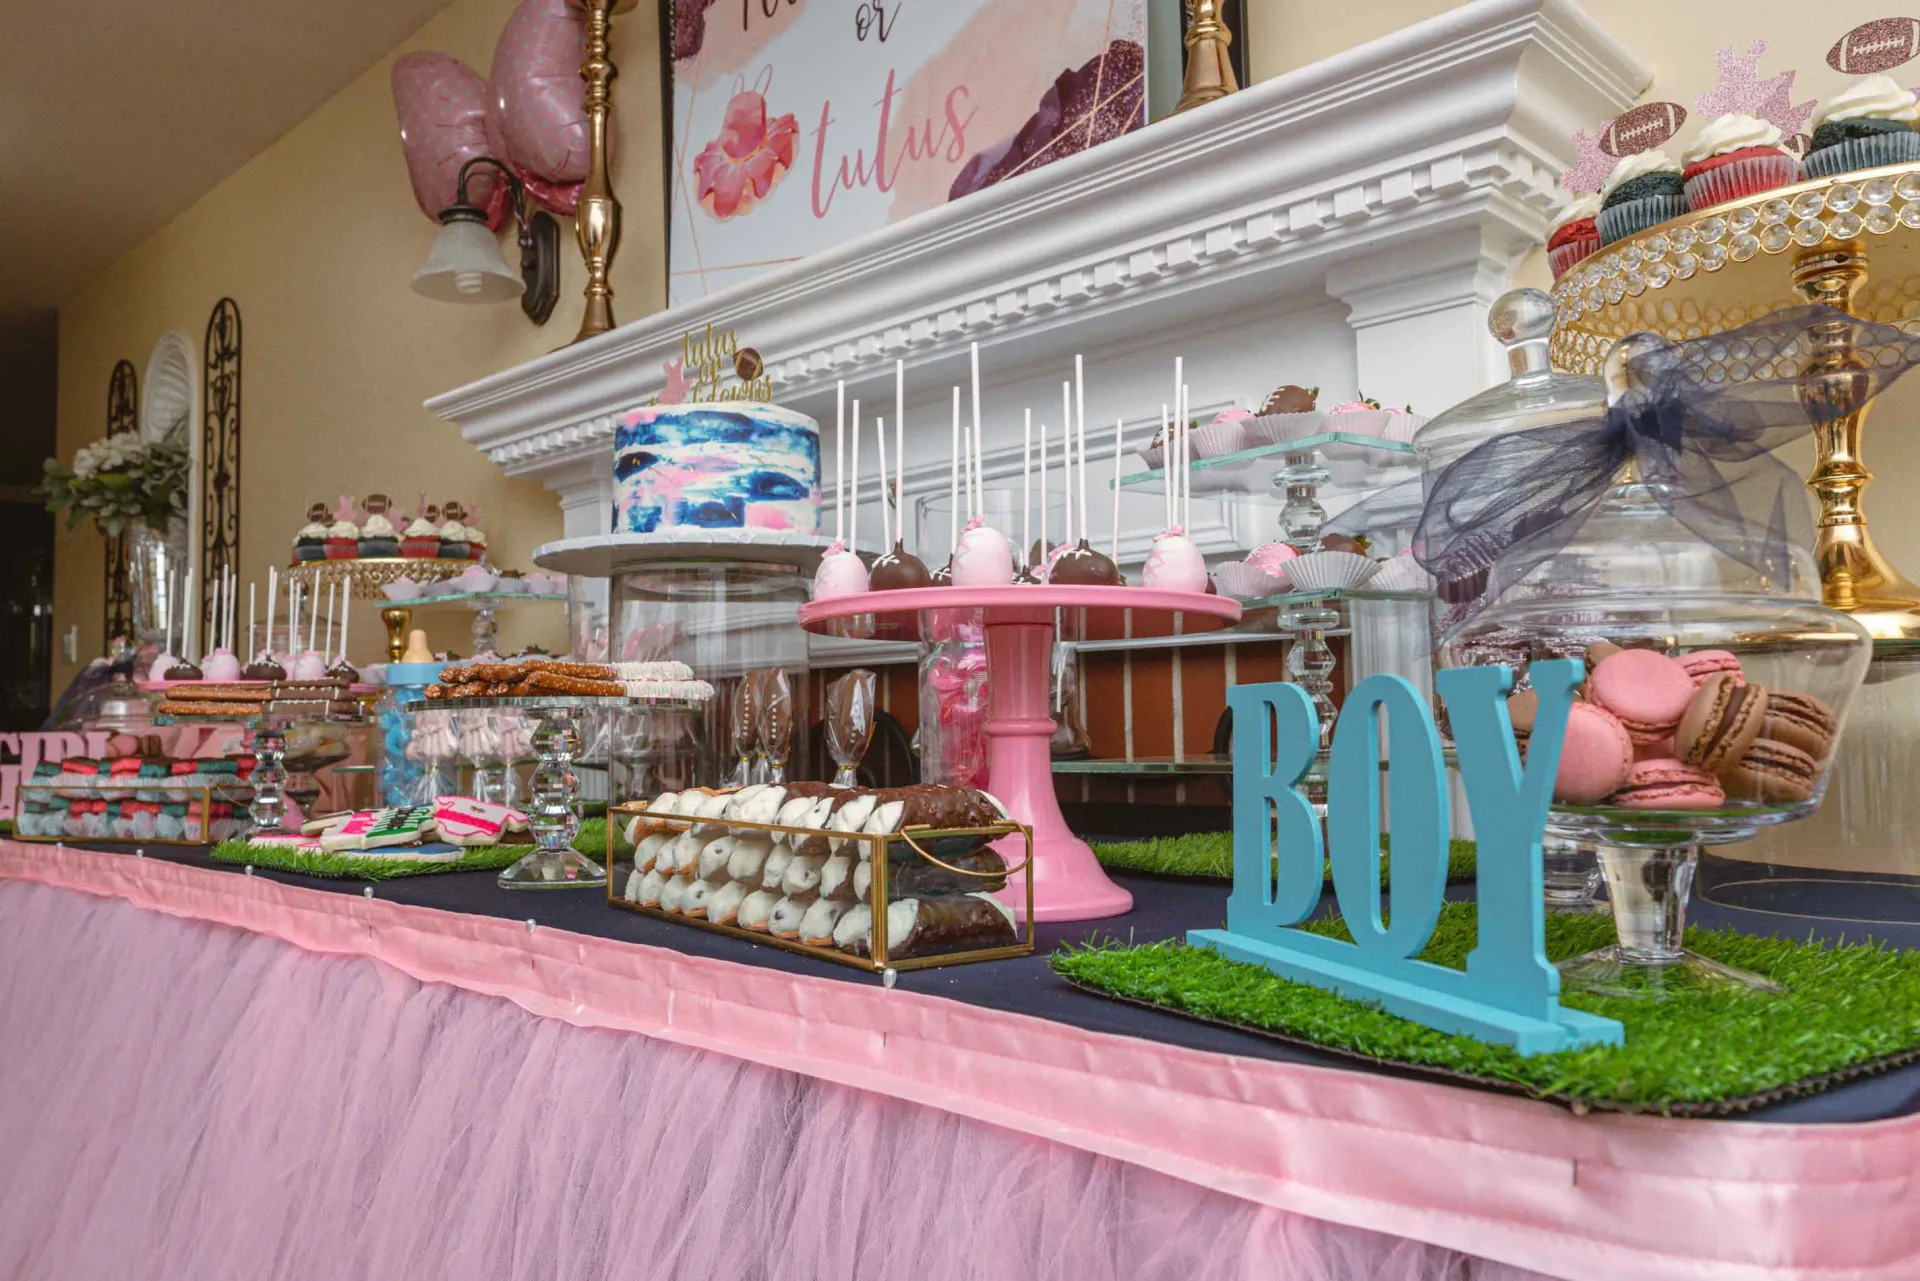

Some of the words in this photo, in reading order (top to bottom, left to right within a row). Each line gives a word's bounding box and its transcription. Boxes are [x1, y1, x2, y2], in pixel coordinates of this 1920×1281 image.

[855, 0, 902, 42] or
[809, 68, 979, 219] tutus
[1227, 658, 1586, 1022] BOY
